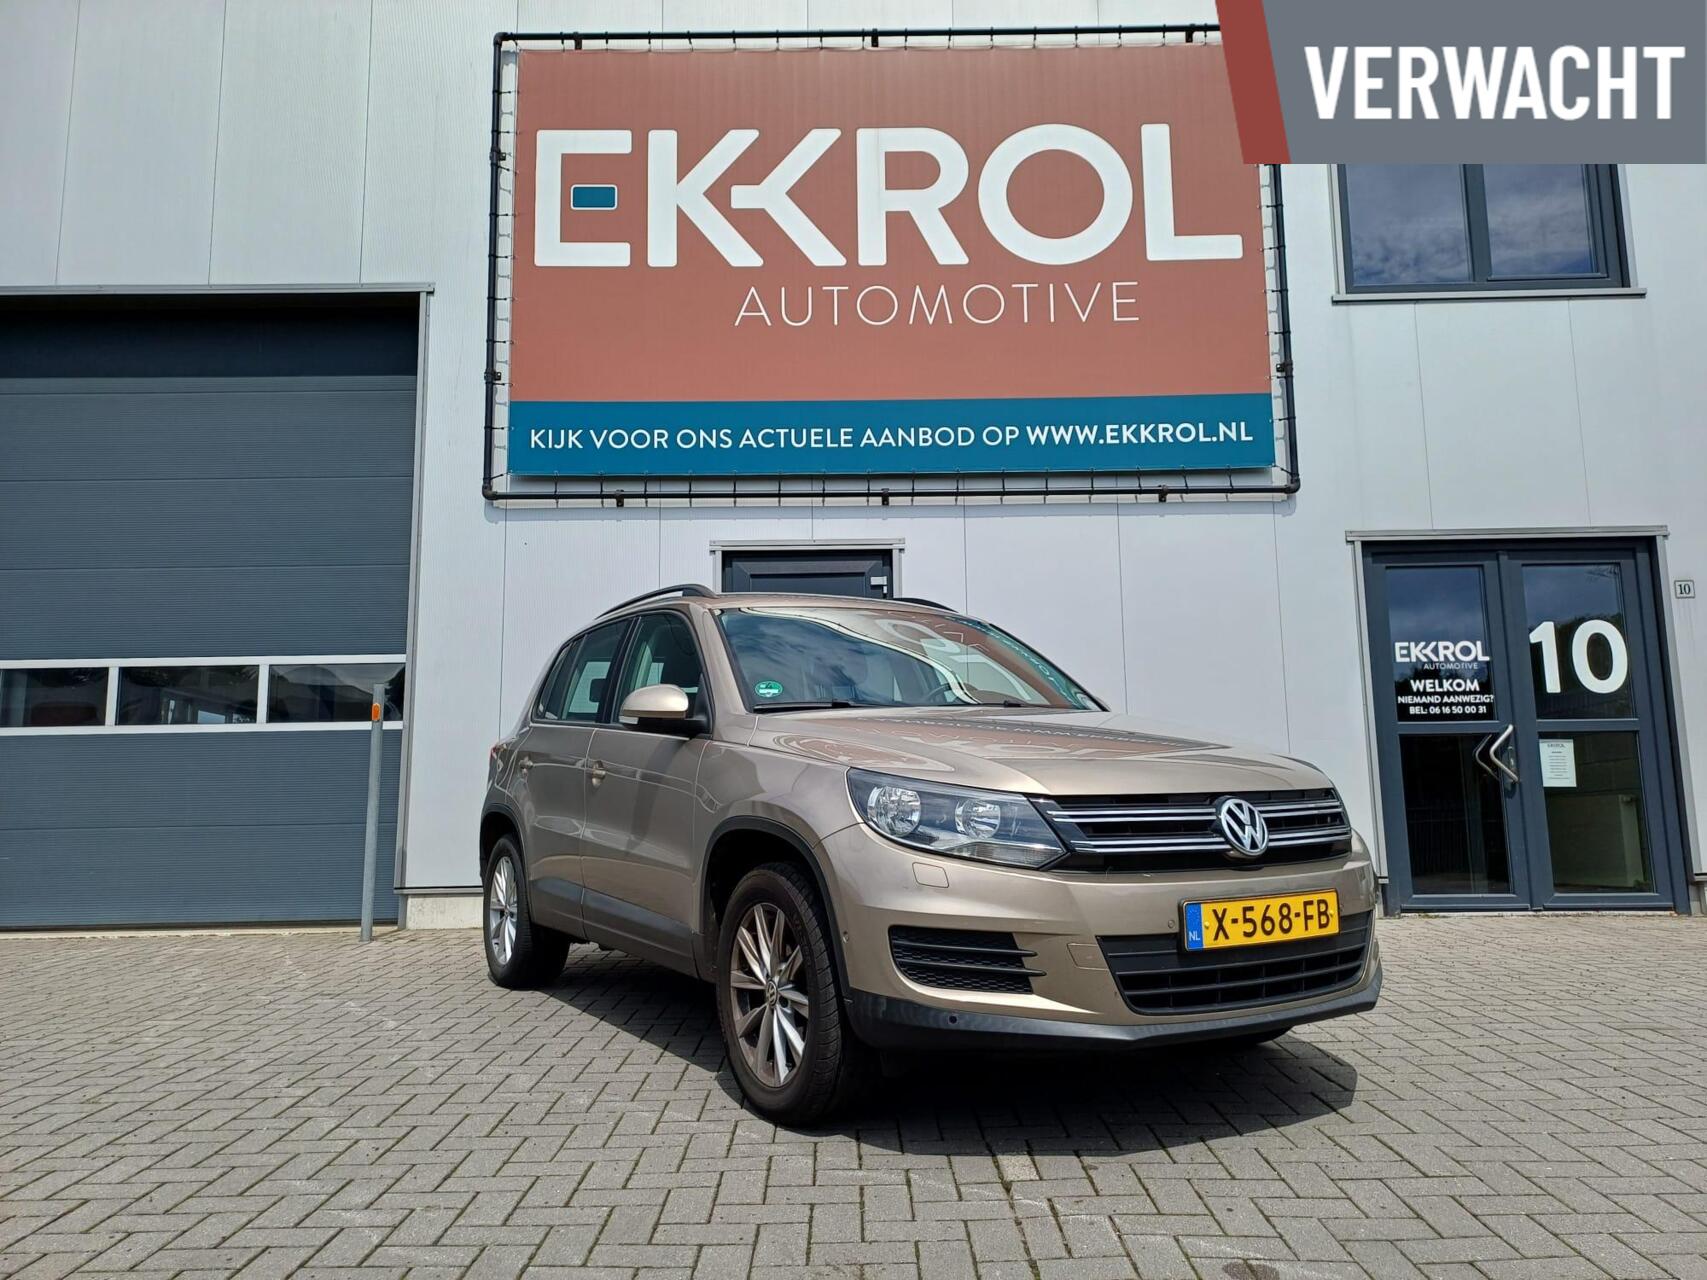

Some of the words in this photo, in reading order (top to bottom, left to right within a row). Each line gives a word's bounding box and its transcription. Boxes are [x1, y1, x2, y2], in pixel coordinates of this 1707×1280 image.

[533, 123, 1243, 268] EKKROL
[734, 280, 1139, 327] AUTOMOTIVE
[530, 429, 583, 449] KIJK
[590, 429, 669, 449] VOOR
[676, 428, 732, 449] ONS
[739, 428, 853, 448] ACTUELE
[860, 426, 975, 447] AANBOD
[982, 426, 1020, 446] OP
[1026, 422, 1254, 445] WWW.EKKROL.NL
[1678, 583, 1691, 595] 10
[1395, 641, 1490, 662] EKKROL
[1529, 619, 1628, 694] 10
[1423, 662, 1479, 670] AUTOMOTIVE
[1410, 679, 1480, 692] WELKOM
[1397, 695, 1441, 704] NIEMAND
[1442, 694, 1495, 703] AANWEZIG?
[1429, 706, 1441, 714] 06
[1451, 706, 1463, 714] 50
[1464, 705, 1477, 713] 00
[1478, 705, 1487, 713] 31
[1188, 930, 1201, 941] NL
[1211, 898, 1331, 941] X-568-FB
